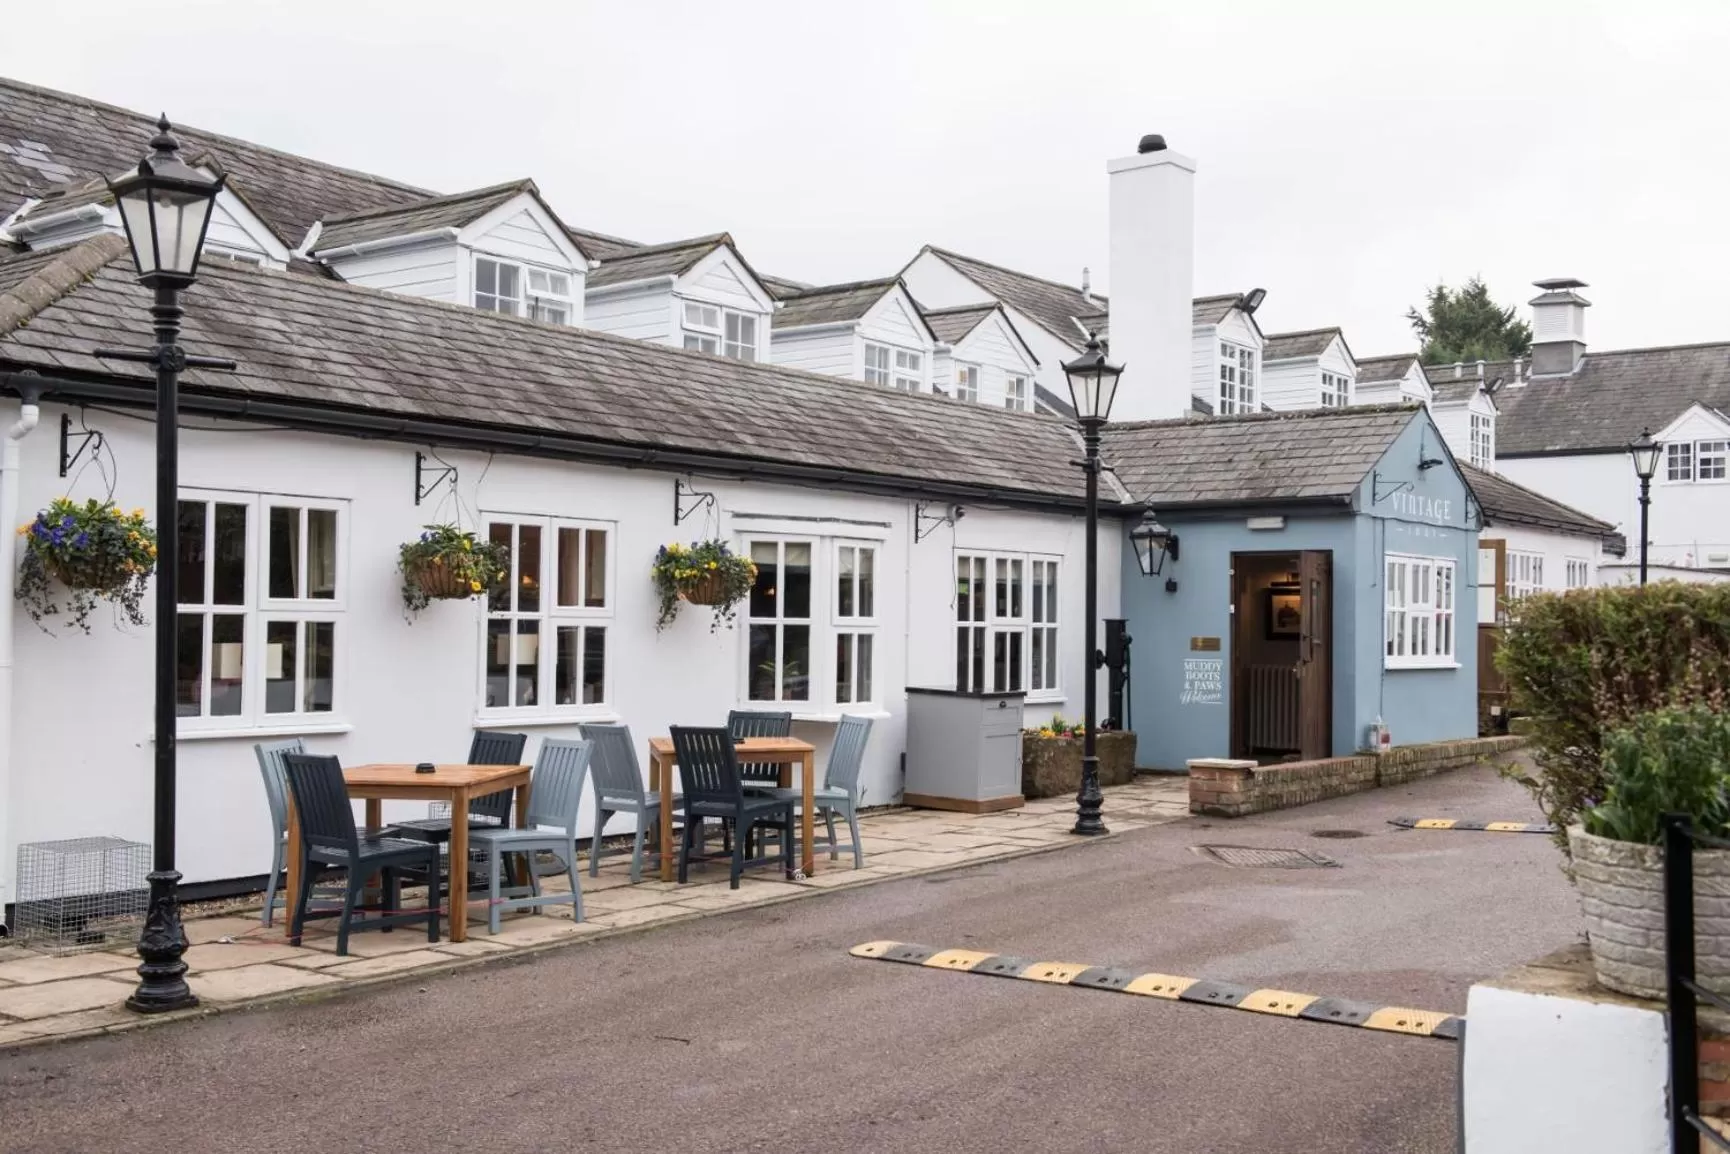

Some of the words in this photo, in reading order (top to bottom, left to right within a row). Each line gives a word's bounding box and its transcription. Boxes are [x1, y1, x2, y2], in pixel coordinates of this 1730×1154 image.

[1392, 491, 1452, 524] VINTAGE
[1184, 661, 1221, 671] MUDDY
[1185, 671, 1220, 681] BOOTS
[1194, 680, 1222, 690] PAWS
